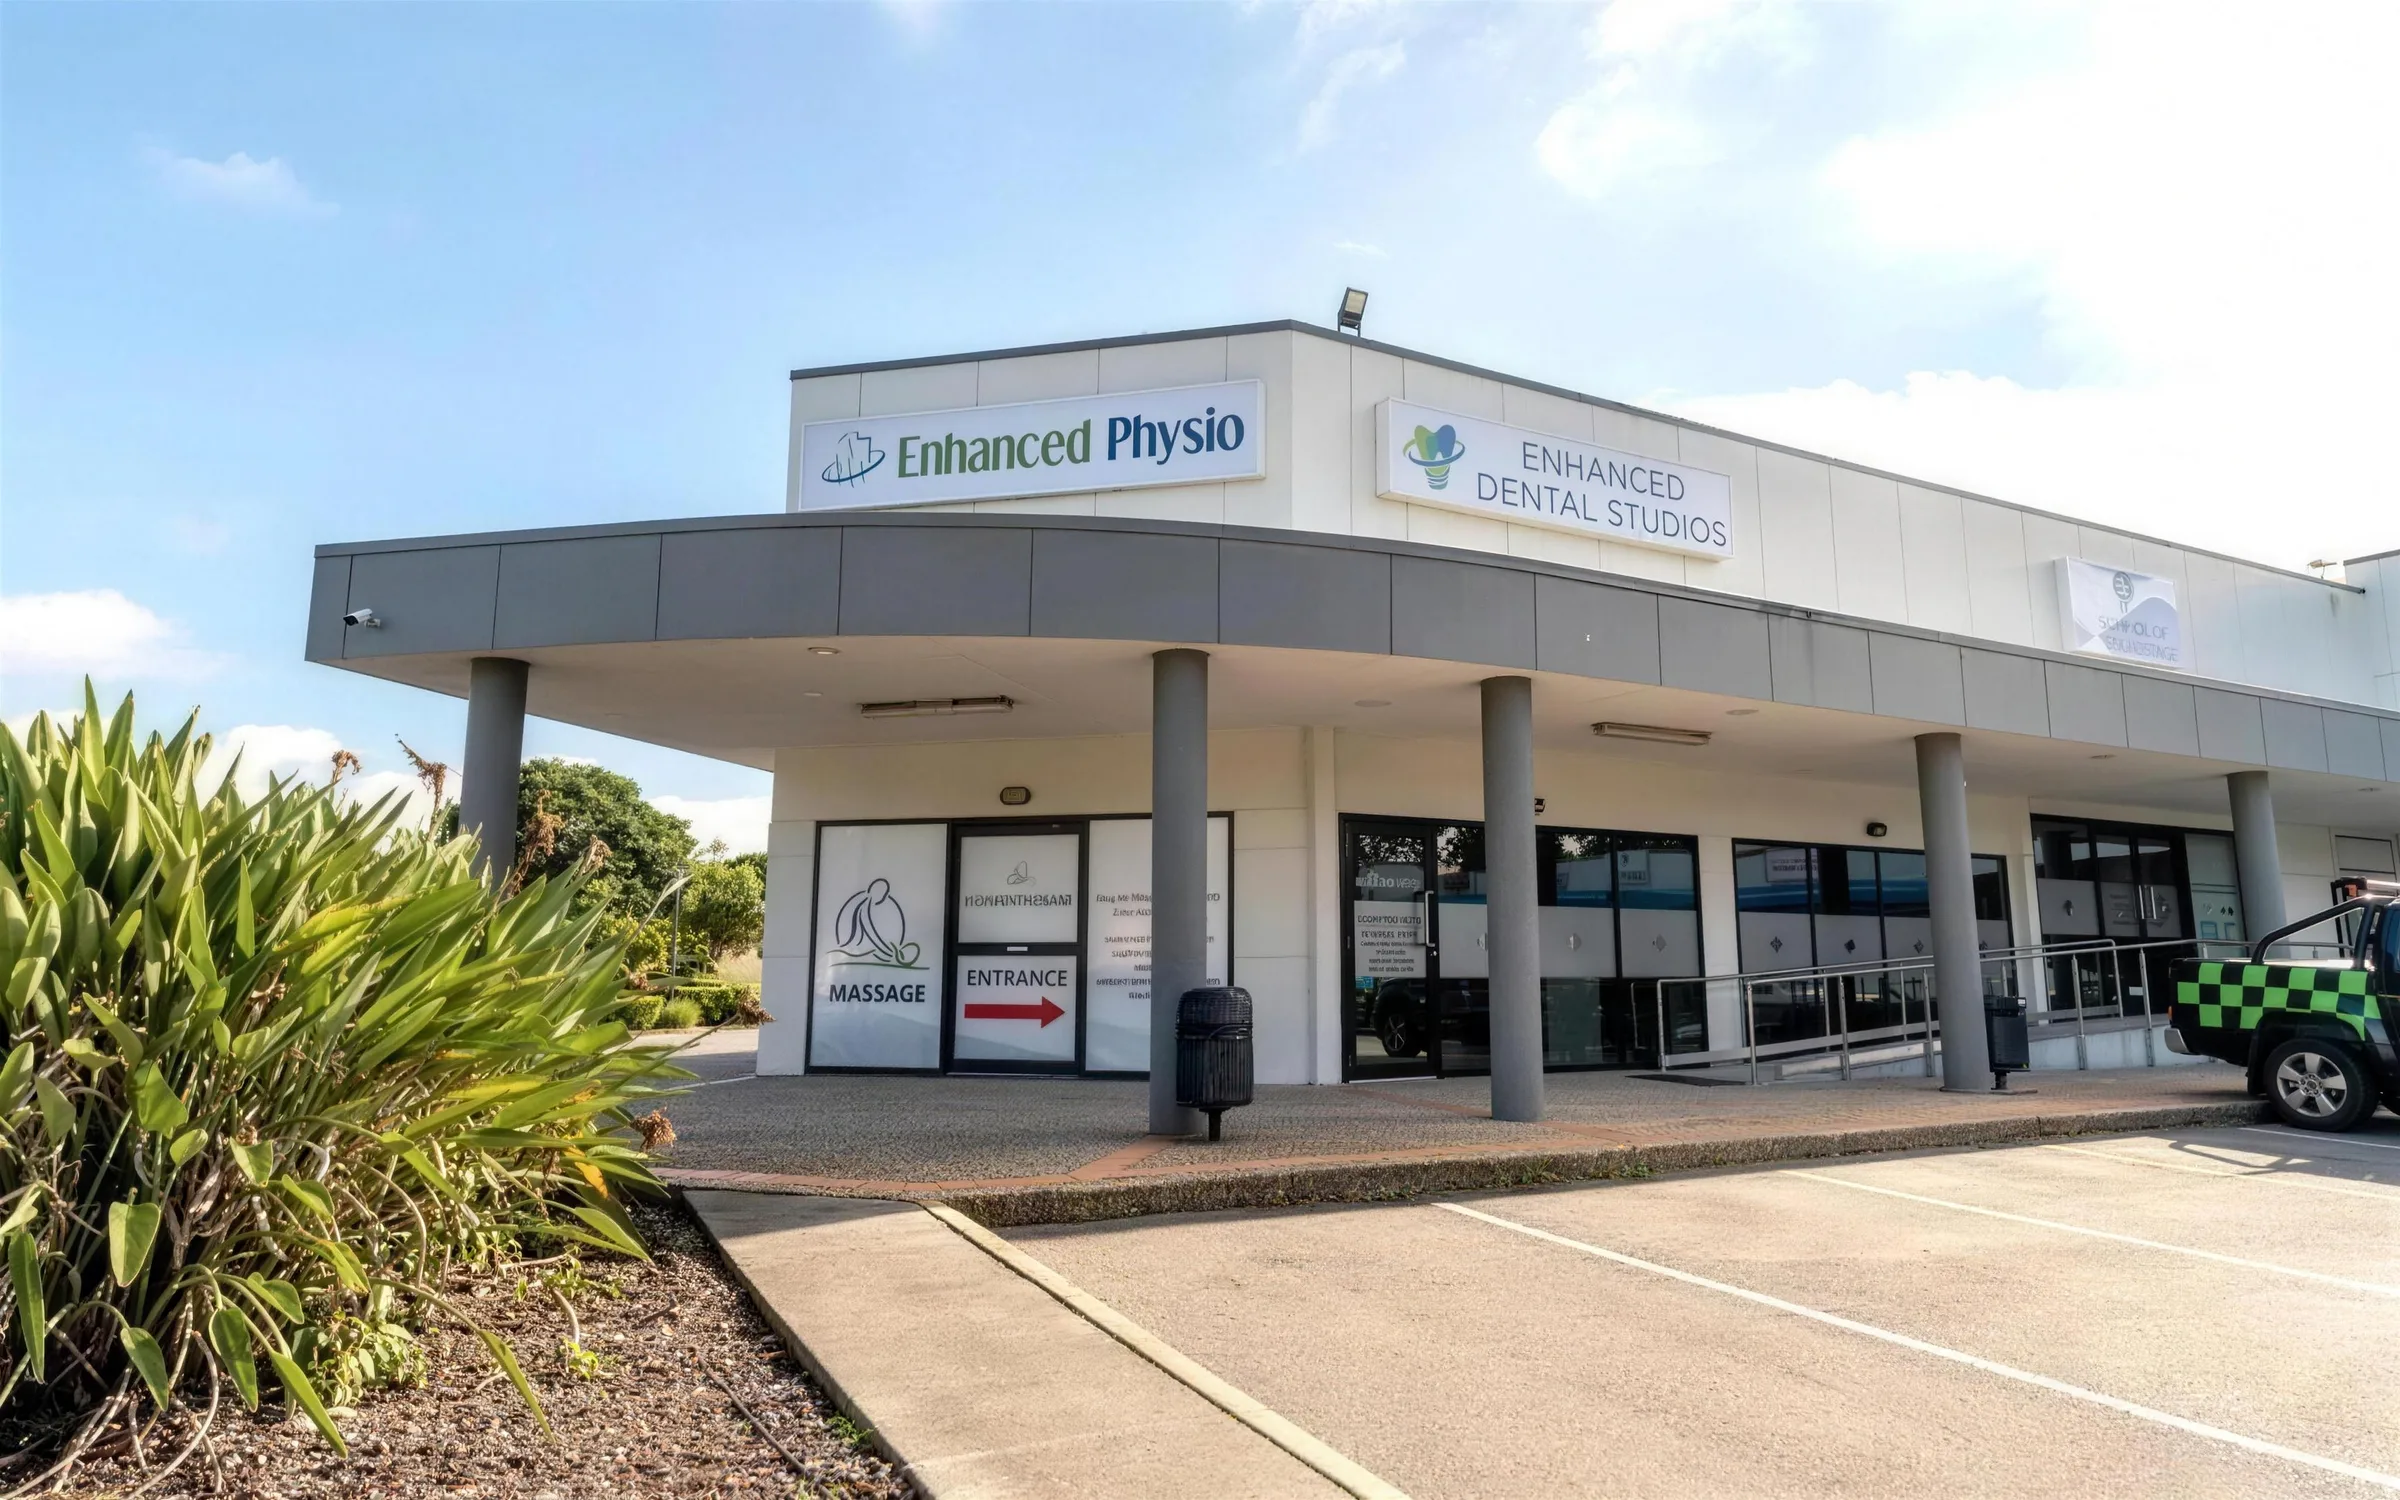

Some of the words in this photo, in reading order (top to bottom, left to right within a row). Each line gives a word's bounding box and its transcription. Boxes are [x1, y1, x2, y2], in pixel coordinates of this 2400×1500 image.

[898, 419, 1091, 478] Enhanced
[1107, 407, 1244, 465] Physio
[1522, 441, 1685, 500] ENHANCED
[1477, 472, 1598, 522] DENTAL
[1607, 500, 1727, 547] STUDIOS
[829, 984, 926, 1003] MASSAGE
[967, 969, 1068, 987] ENTRANCE
